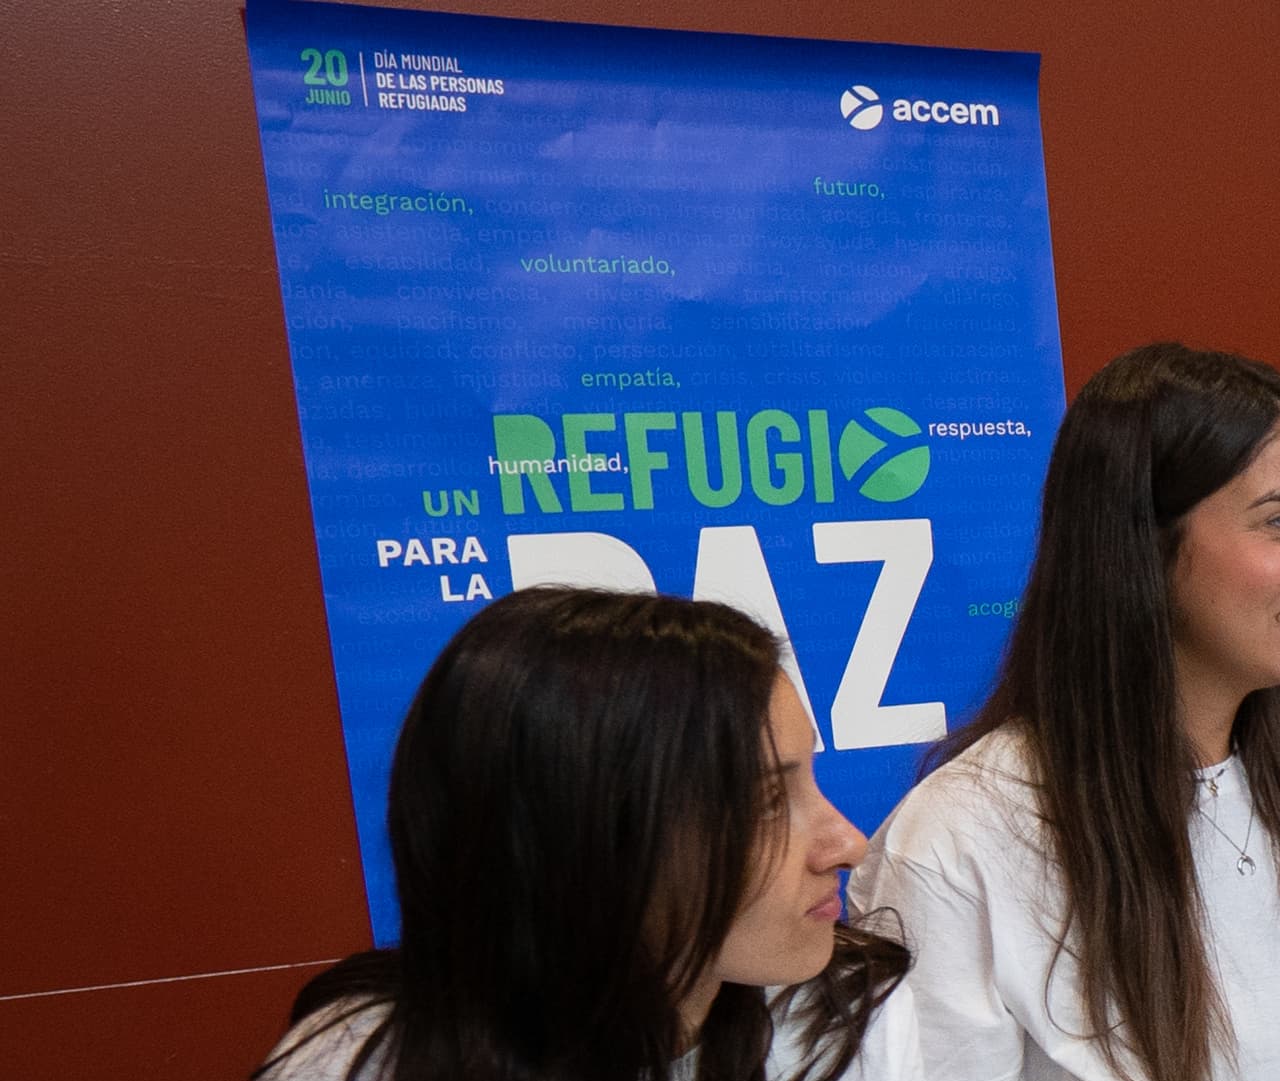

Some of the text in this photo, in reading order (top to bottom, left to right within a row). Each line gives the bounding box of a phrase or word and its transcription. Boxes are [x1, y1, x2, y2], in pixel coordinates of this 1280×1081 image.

[301, 48, 349, 87] 20
[374, 50, 463, 73] DÍA MUNDIAL
[376, 72, 504, 95] DE LAS PERSONAS
[305, 89, 351, 106] JUNIO
[379, 93, 467, 112] REFUGIADAS
[893, 99, 1000, 127] accem
[813, 177, 886, 200] futuro,
[324, 189, 474, 216] integración,
[521, 253, 675, 277] voluntariado,
[581, 366, 680, 391] empatía,
[928, 416, 1031, 440] respuesta,
[488, 451, 629, 477] humanidad,
[422, 489, 480, 518] UN
[376, 537, 488, 568] PARA
[440, 573, 493, 602] LA
[967, 599, 1019, 618] acogi
[507, 518, 948, 753] AZ
